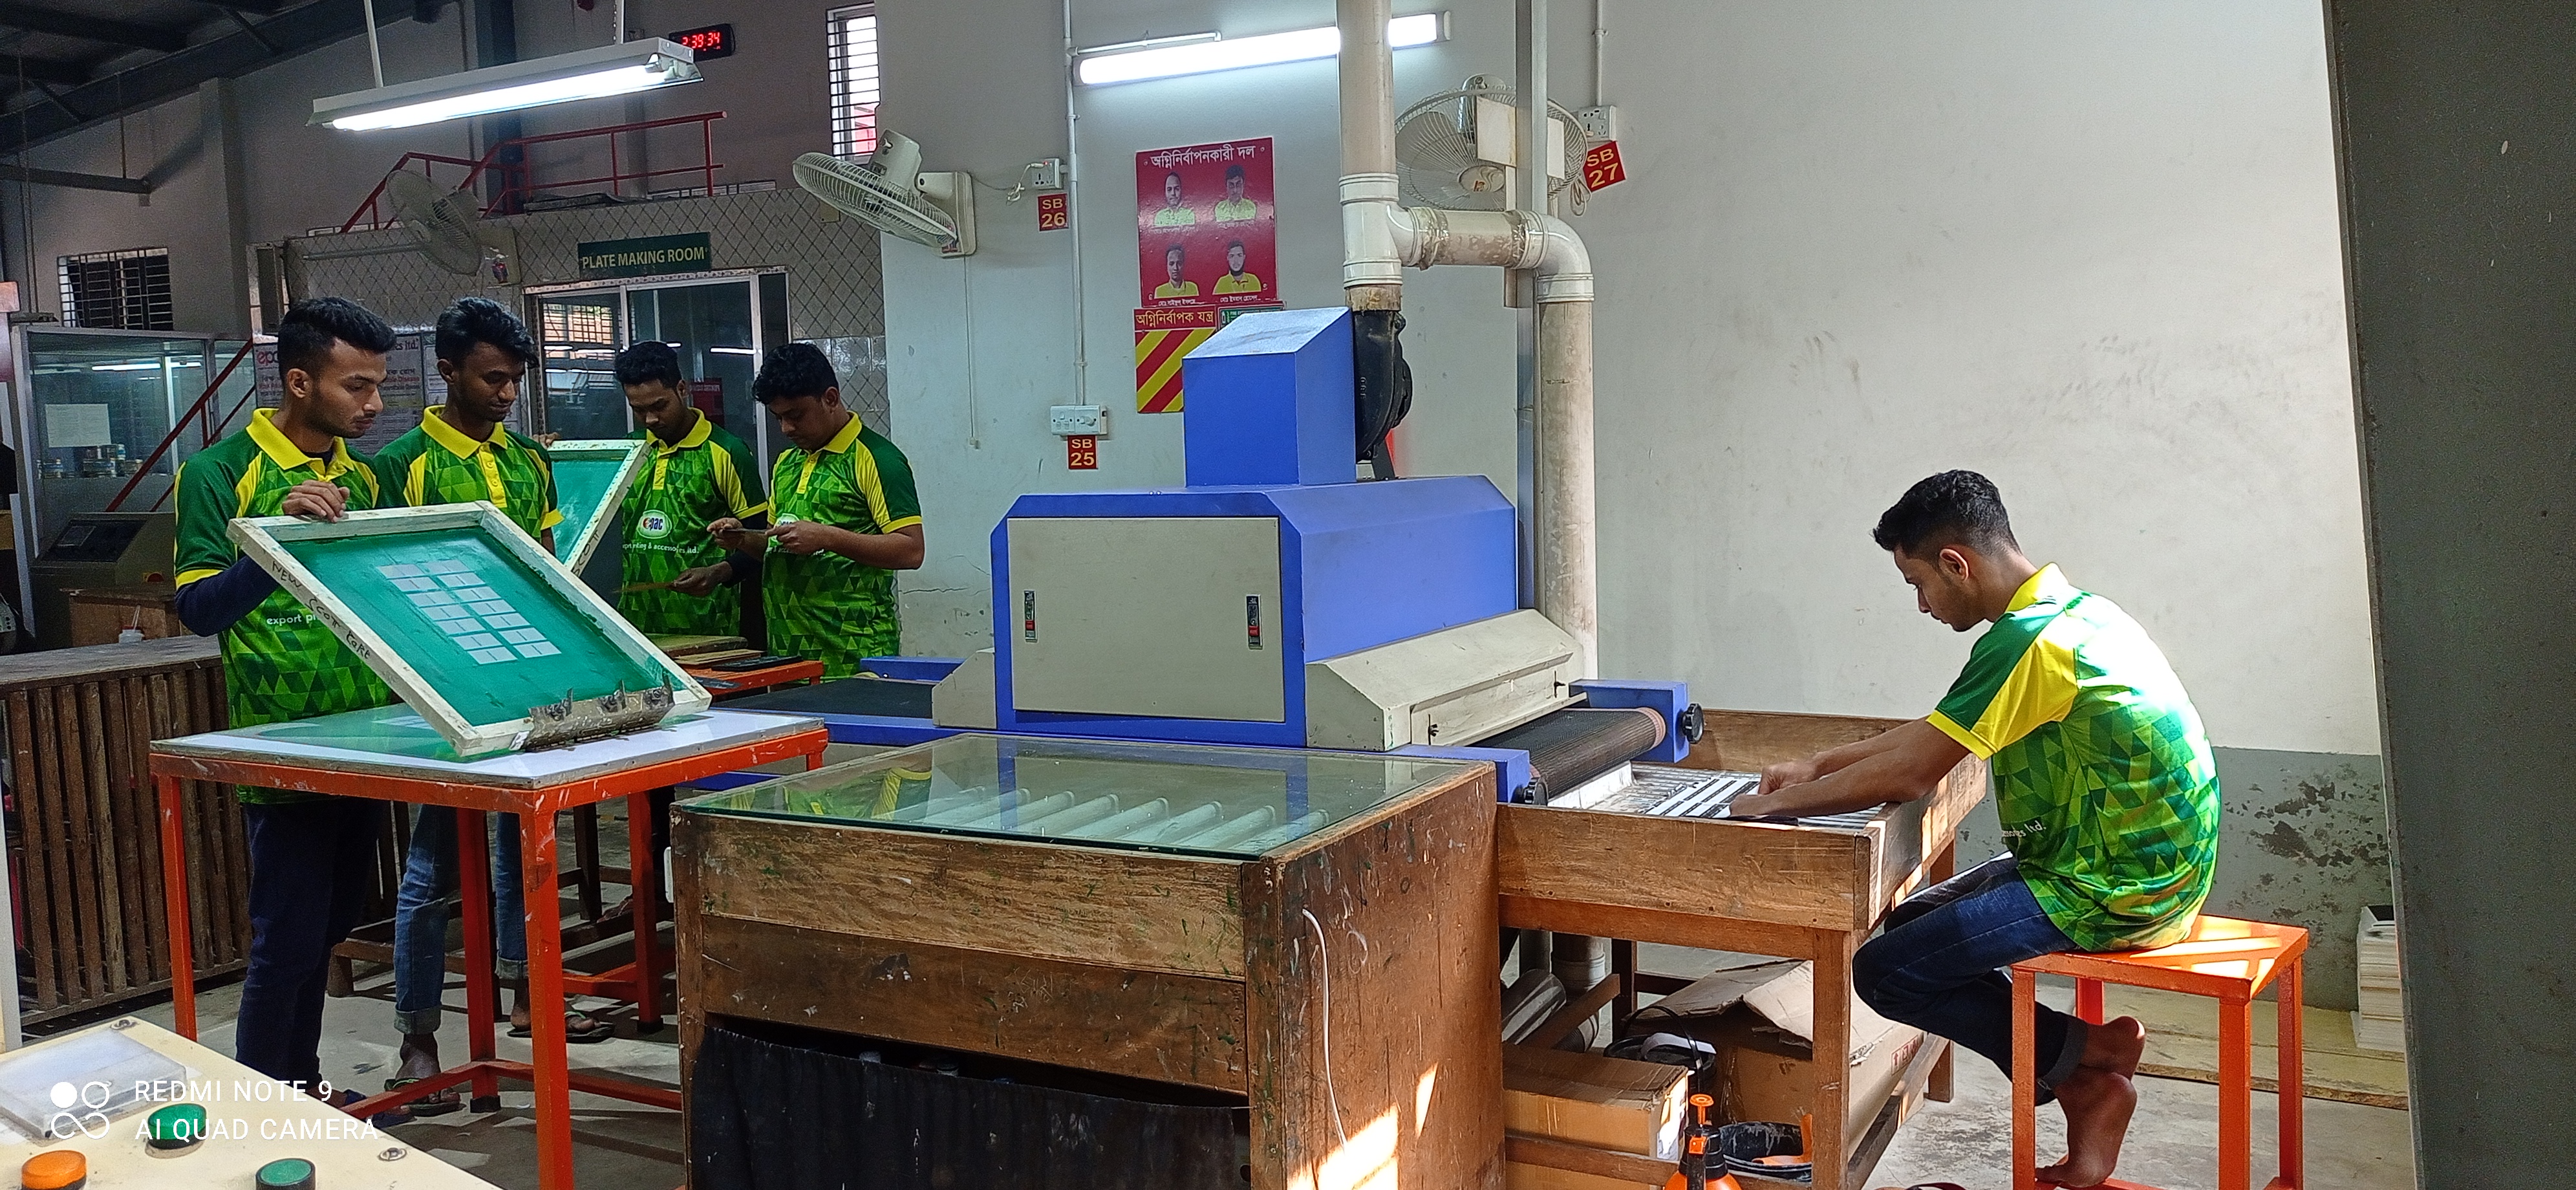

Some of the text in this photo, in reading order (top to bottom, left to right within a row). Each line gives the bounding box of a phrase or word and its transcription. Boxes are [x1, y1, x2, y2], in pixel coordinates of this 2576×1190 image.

[1237, 146, 1256, 160] দল
[1587, 149, 1614, 167] SB
[1589, 162, 1618, 188] 27
[1042, 198, 1063, 210] SB
[1042, 212, 1065, 228] 26
[582, 246, 705, 270] PLATE MAKING ROOM
[1135, 309, 1194, 327] অগ্নিনির্বাপক
[1198, 310, 1214, 323] যন্ত্র
[1071, 439, 1093, 448] SB
[1071, 452, 1095, 466] 25
[272, 560, 303, 588] NEW
[266, 614, 302, 626] export
[2024, 820, 2046, 833] ltd.
